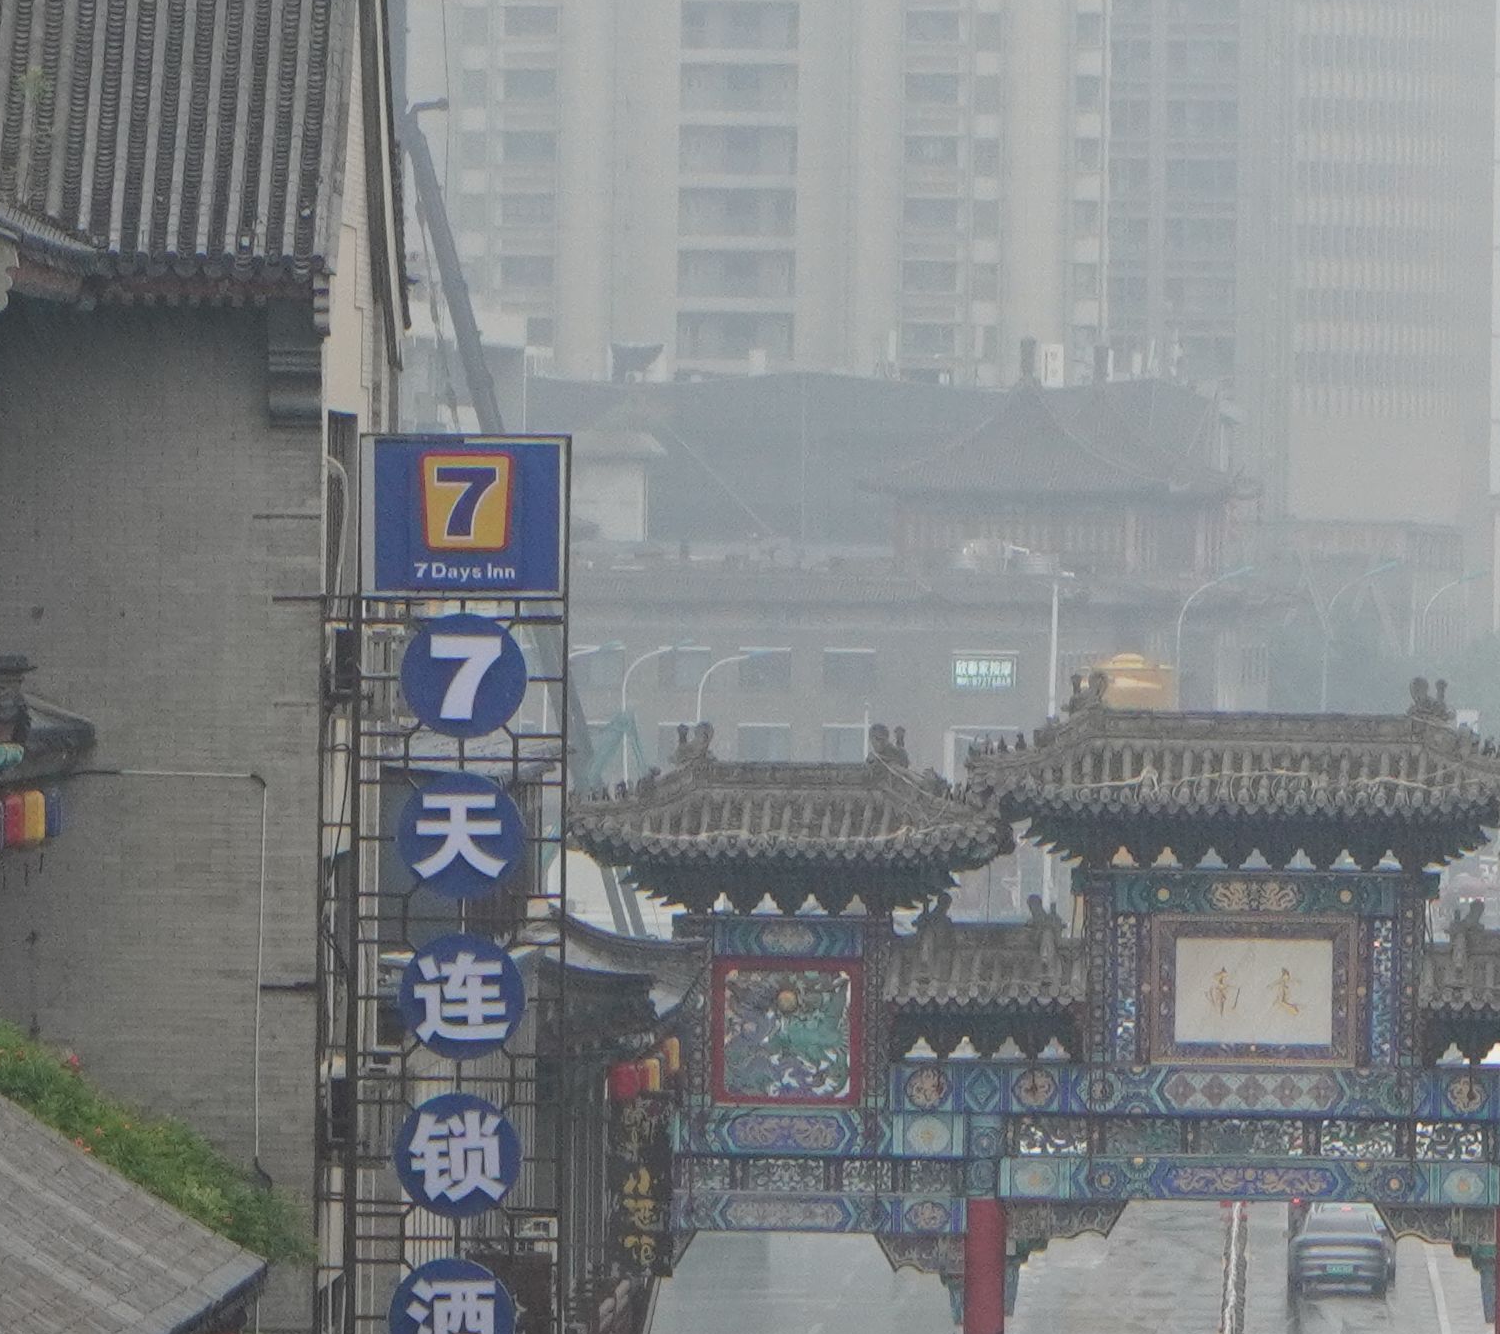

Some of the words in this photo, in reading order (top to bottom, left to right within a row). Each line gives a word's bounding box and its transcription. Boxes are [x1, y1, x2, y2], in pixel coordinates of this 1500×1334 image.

[434, 466, 499, 540] 7
[413, 563, 428, 578] 7
[432, 562, 481, 582] Days
[486, 563, 516, 579] Inn
